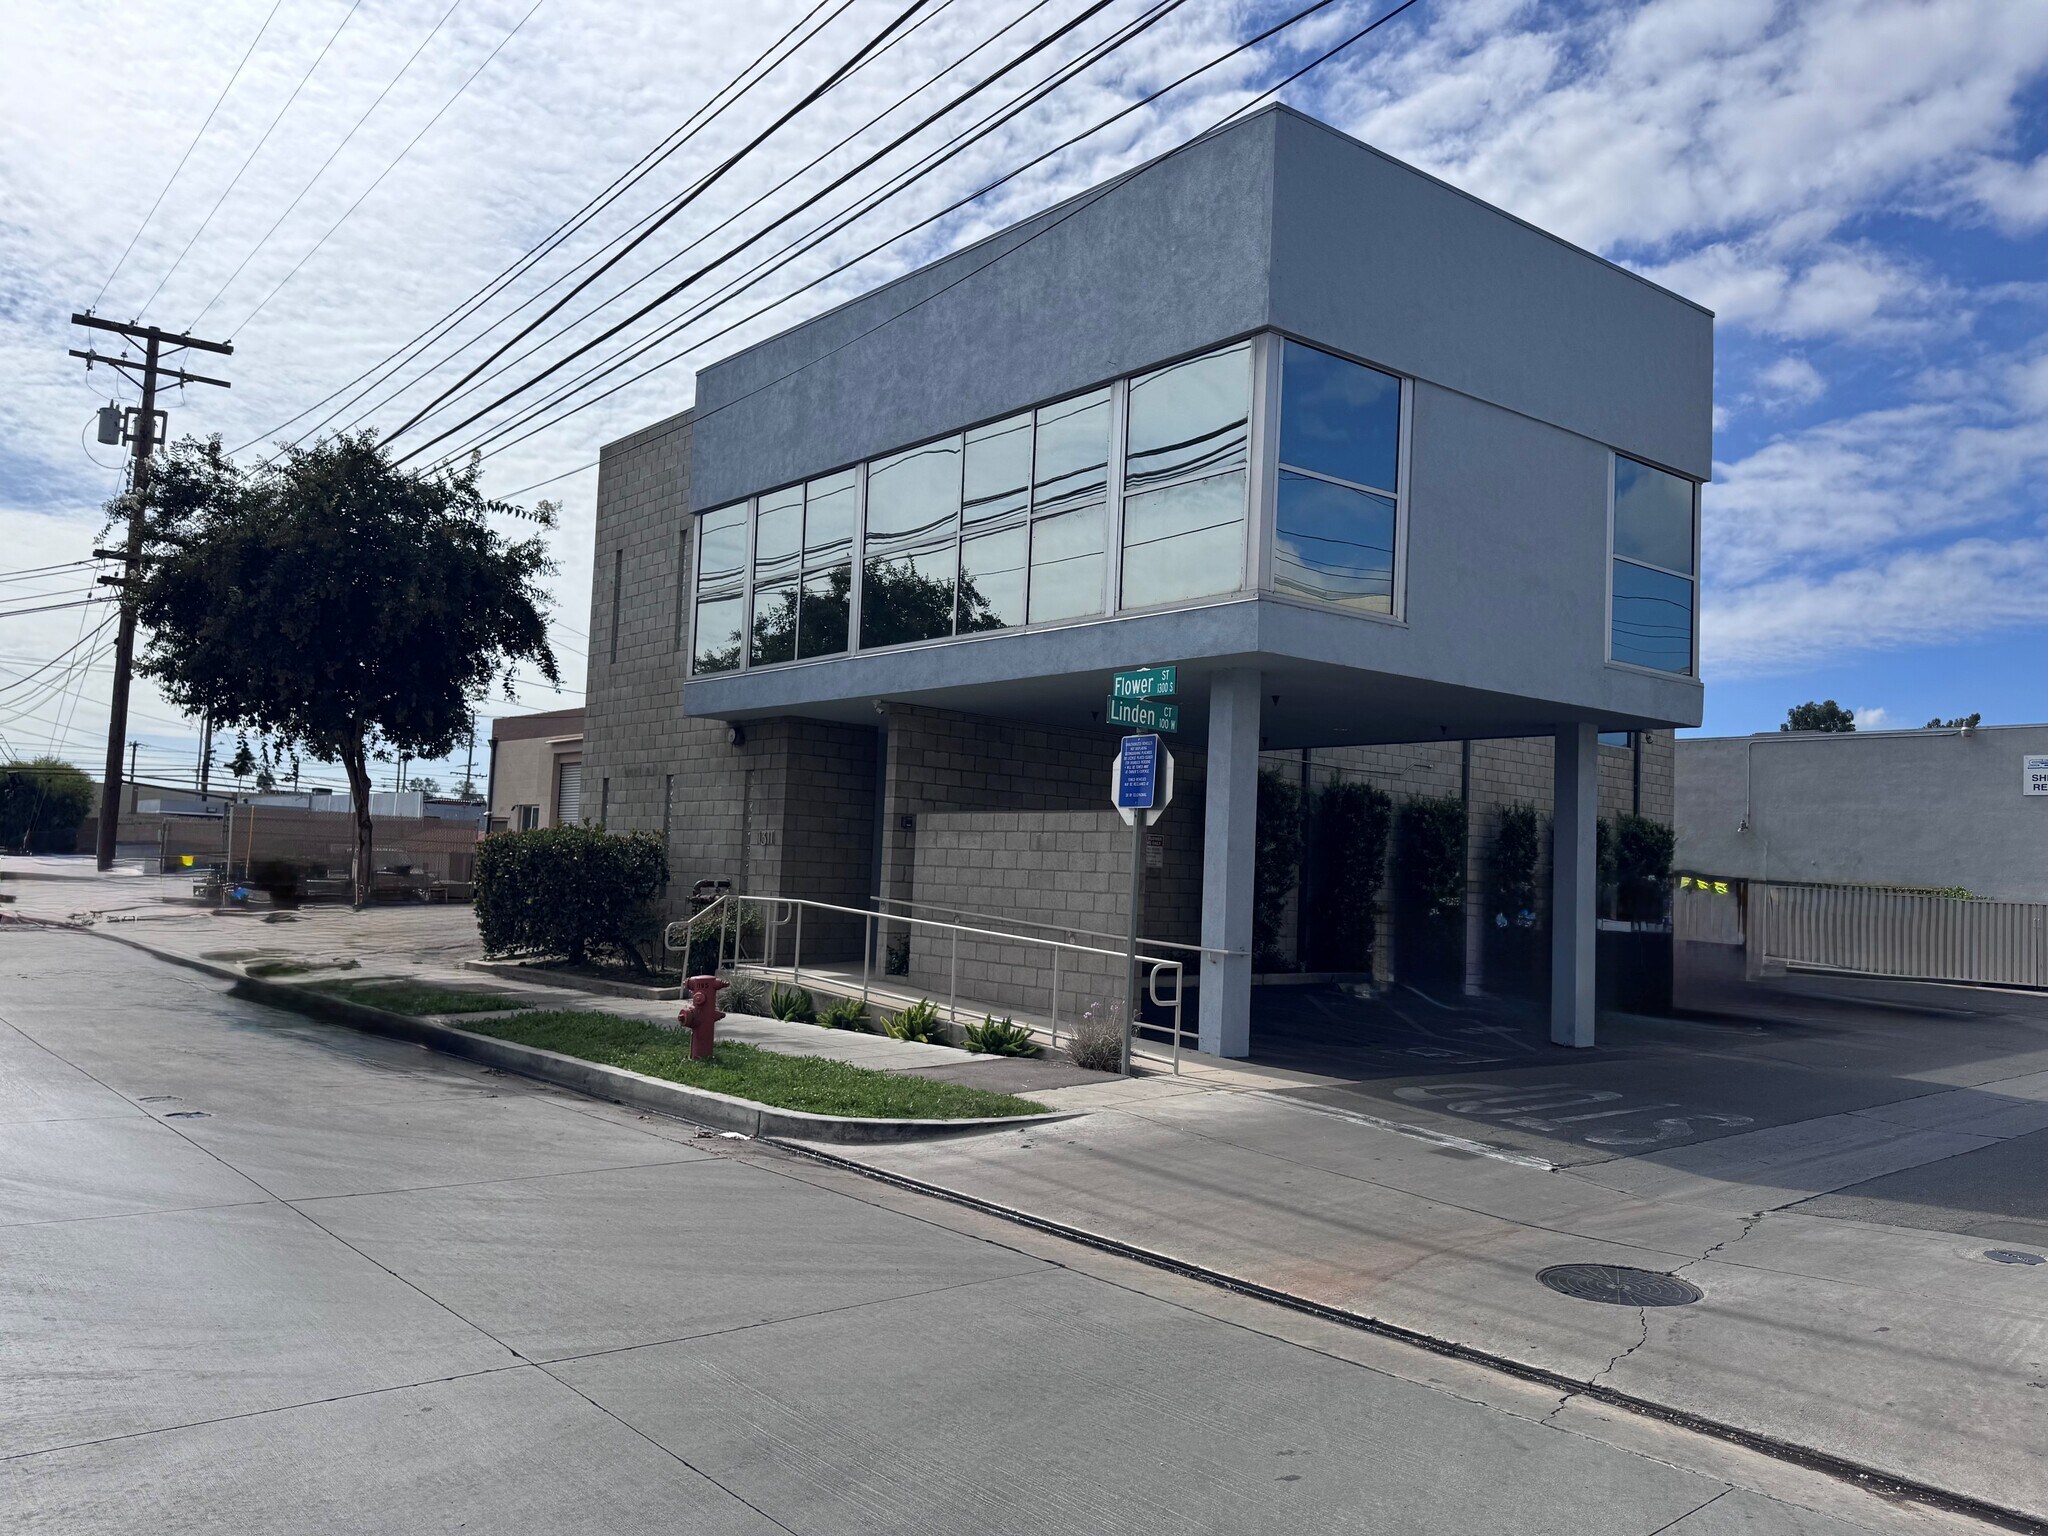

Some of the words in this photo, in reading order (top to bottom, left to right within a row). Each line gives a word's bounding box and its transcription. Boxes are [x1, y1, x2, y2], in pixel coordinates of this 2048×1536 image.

[1115, 677, 1153, 696] Flower
[1162, 670, 1169, 680] ST
[1157, 683, 1168, 693] 1300
[1169, 682, 1173, 692] S
[1111, 700, 1154, 725] Linden
[1164, 707, 1172, 717] CT
[1159, 718, 1169, 729] 100
[1171, 720, 1175, 730] W
